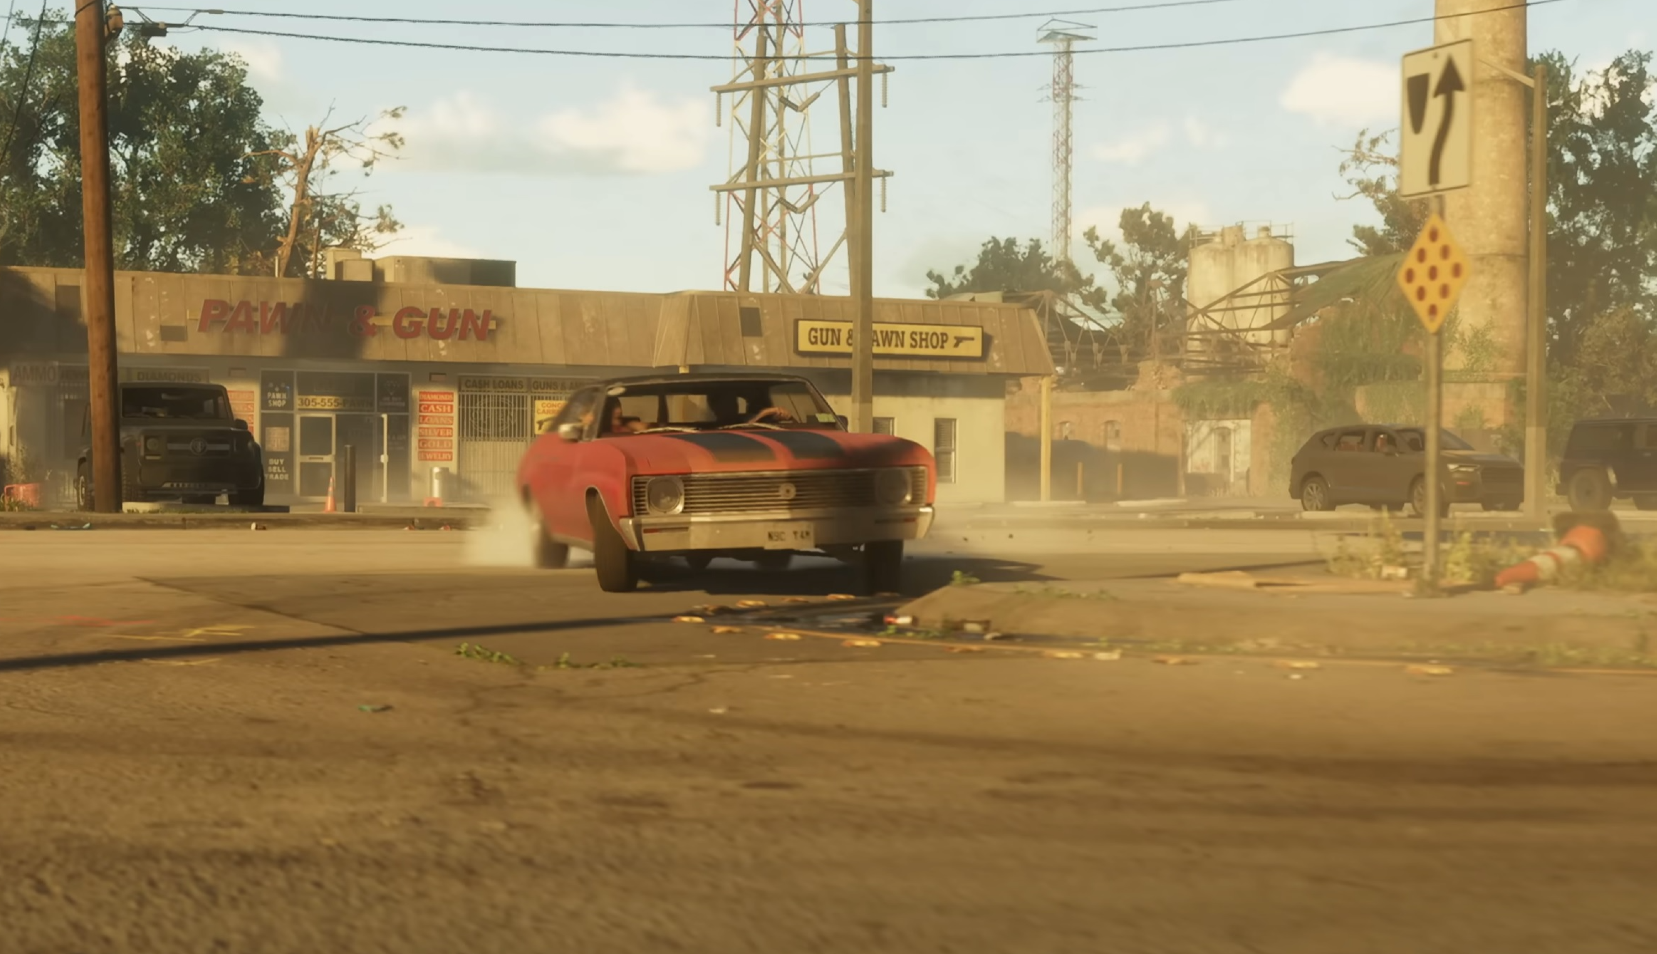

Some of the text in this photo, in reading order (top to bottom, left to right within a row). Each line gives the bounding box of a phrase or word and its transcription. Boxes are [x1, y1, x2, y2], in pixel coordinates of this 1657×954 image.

[197, 299, 492, 341] PAWN & GUN
[808, 327, 841, 346] GUN
[872, 330, 905, 348] AWN
[910, 331, 948, 349] SHOP
[13, 365, 57, 382] AMMO
[137, 371, 201, 382] DIAMONDS
[464, 379, 524, 390] CASH LOANS
[532, 380, 558, 390] GUNS
[268, 400, 287, 408] SHOP
[420, 404, 451, 412] CASH
[420, 416, 453, 424] LOANS
[420, 428, 452, 436] SILVER
[420, 440, 452, 448] GOLD
